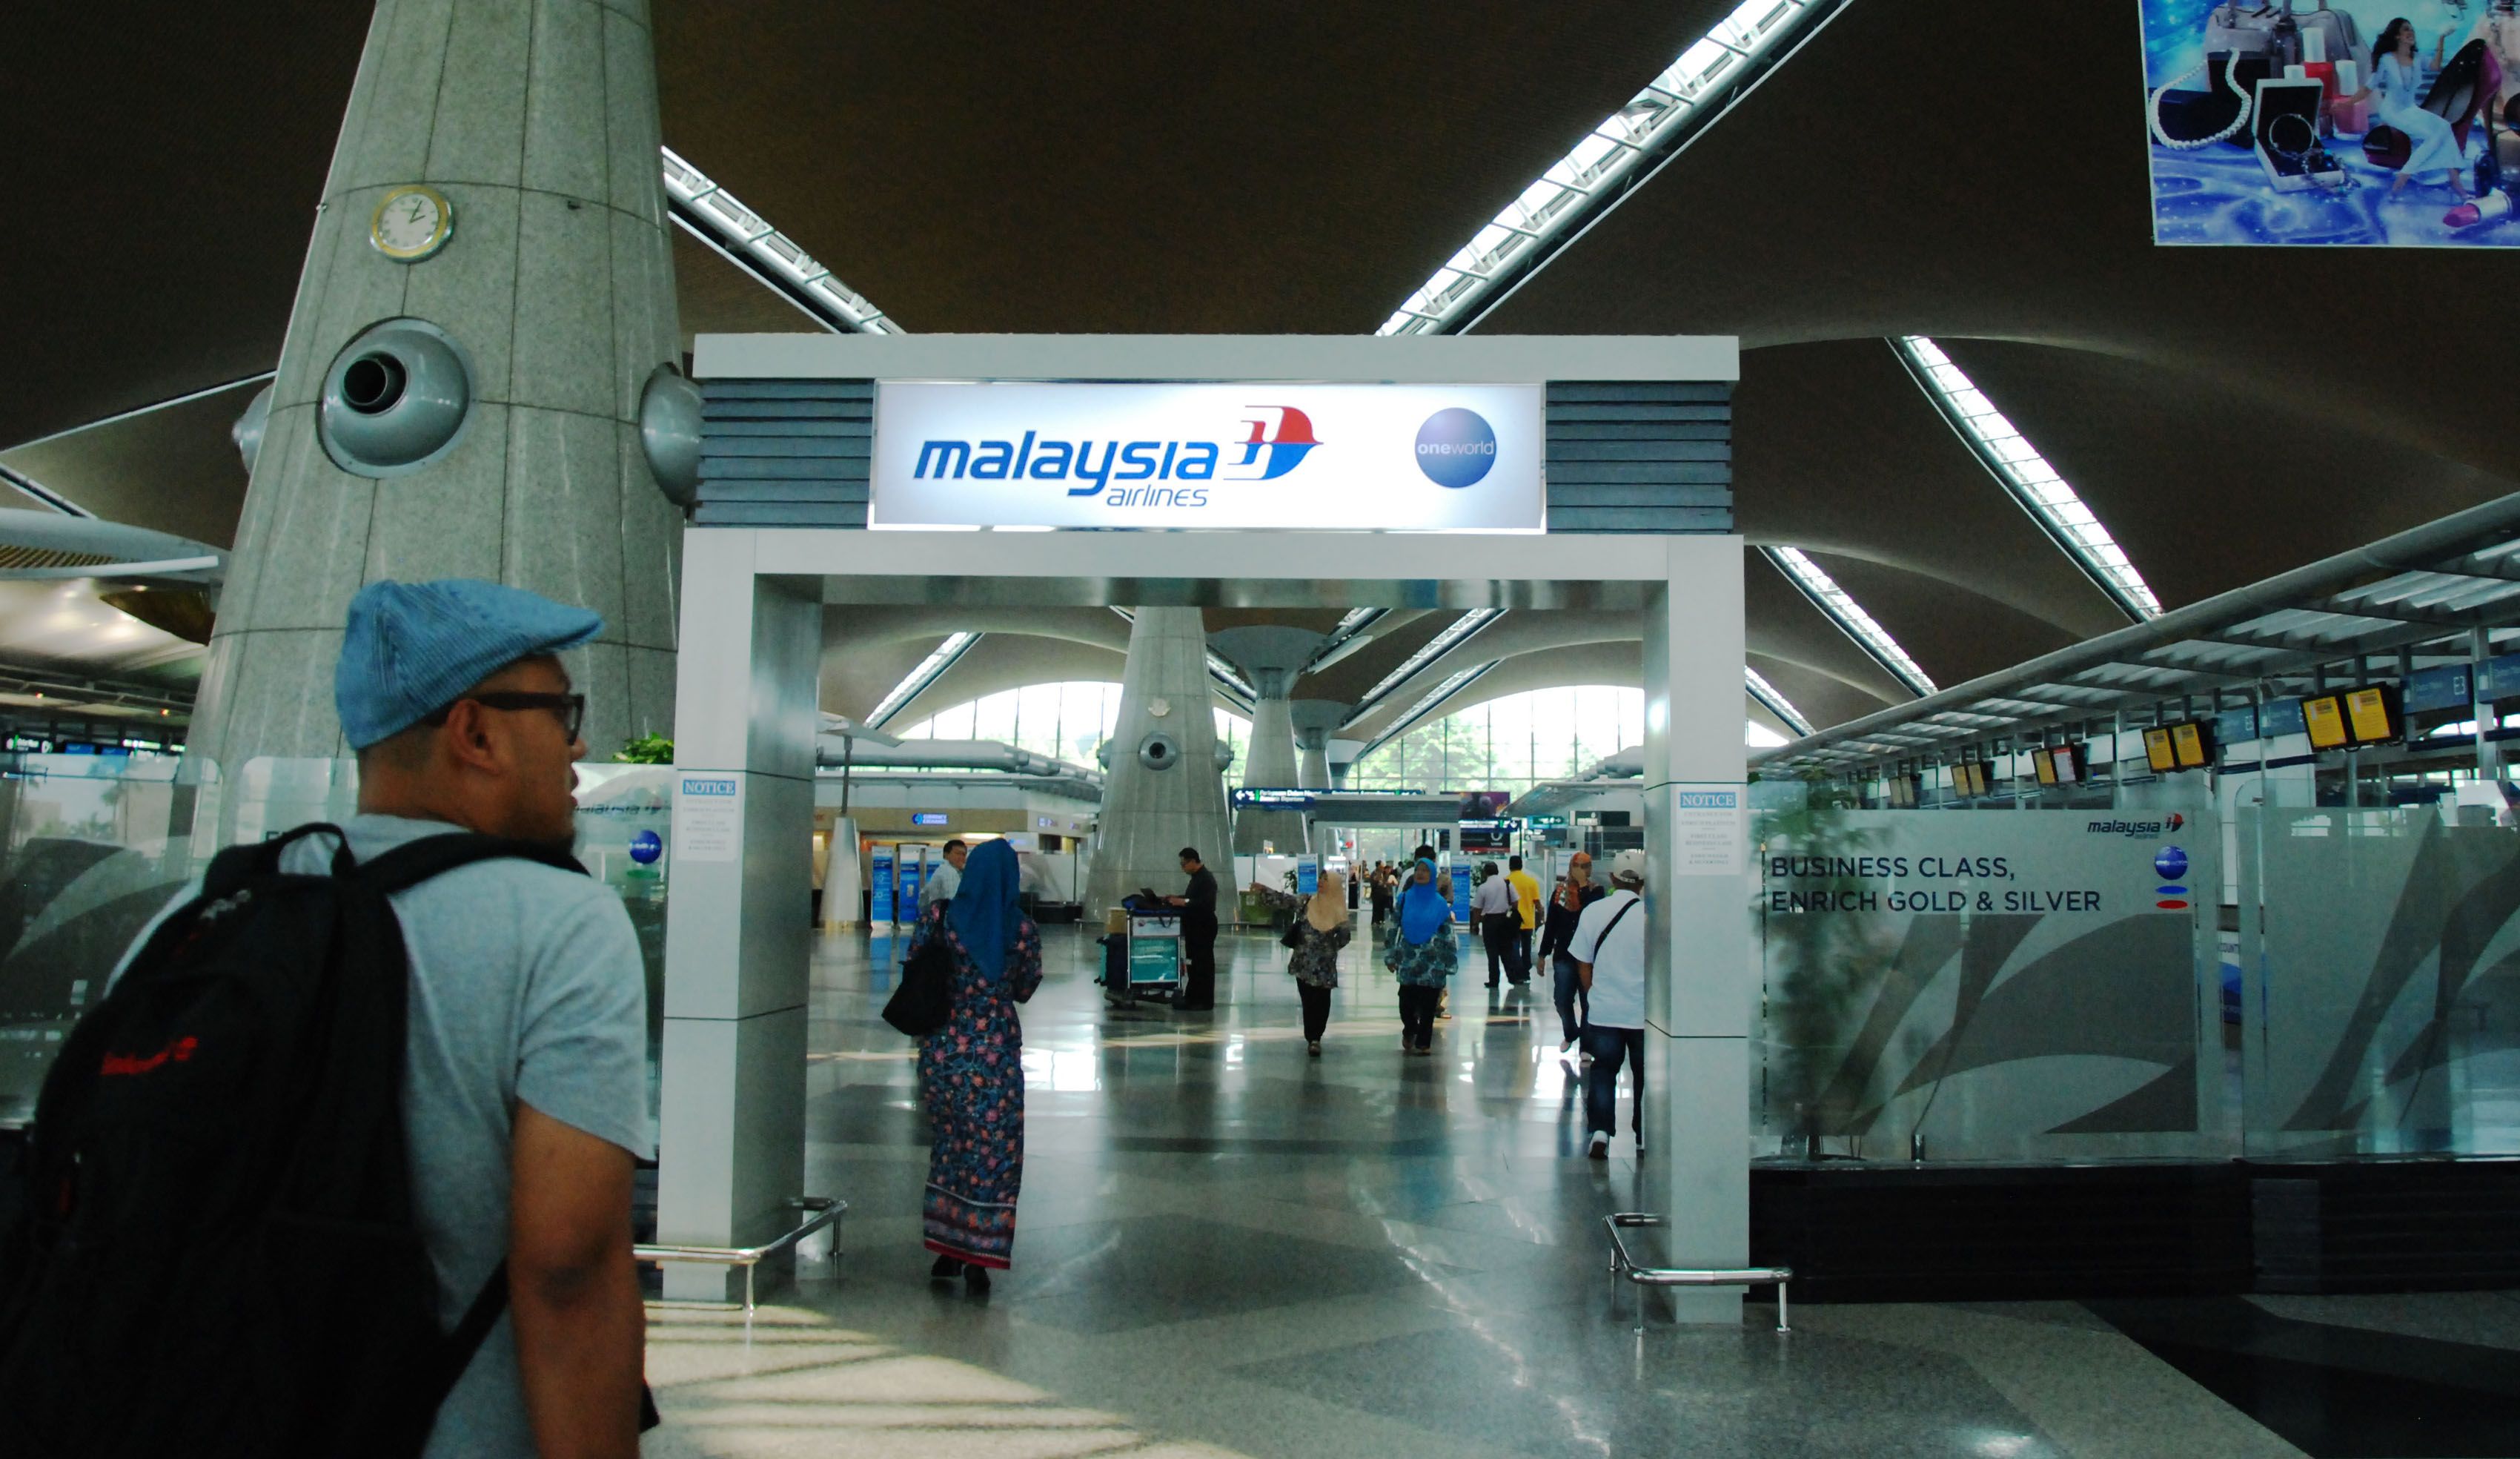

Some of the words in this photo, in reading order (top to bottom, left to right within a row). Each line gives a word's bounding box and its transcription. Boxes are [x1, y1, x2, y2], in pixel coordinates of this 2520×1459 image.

[1416, 440, 1495, 455] oneworld
[913, 430, 1219, 497] malaysia
[1107, 484, 1210, 507] airlines
[684, 781, 735, 795] NOTICE
[1681, 794, 1735, 807] NOTICE
[2087, 820, 2161, 836] malaysia
[1771, 856, 1909, 878] BUSINESS
[1918, 856, 2015, 881] CLASS,
[1772, 890, 1877, 912] ENRICH
[1888, 890, 1966, 912] GOLD
[1976, 890, 1994, 912] &
[2004, 890, 2101, 912] SILVER
